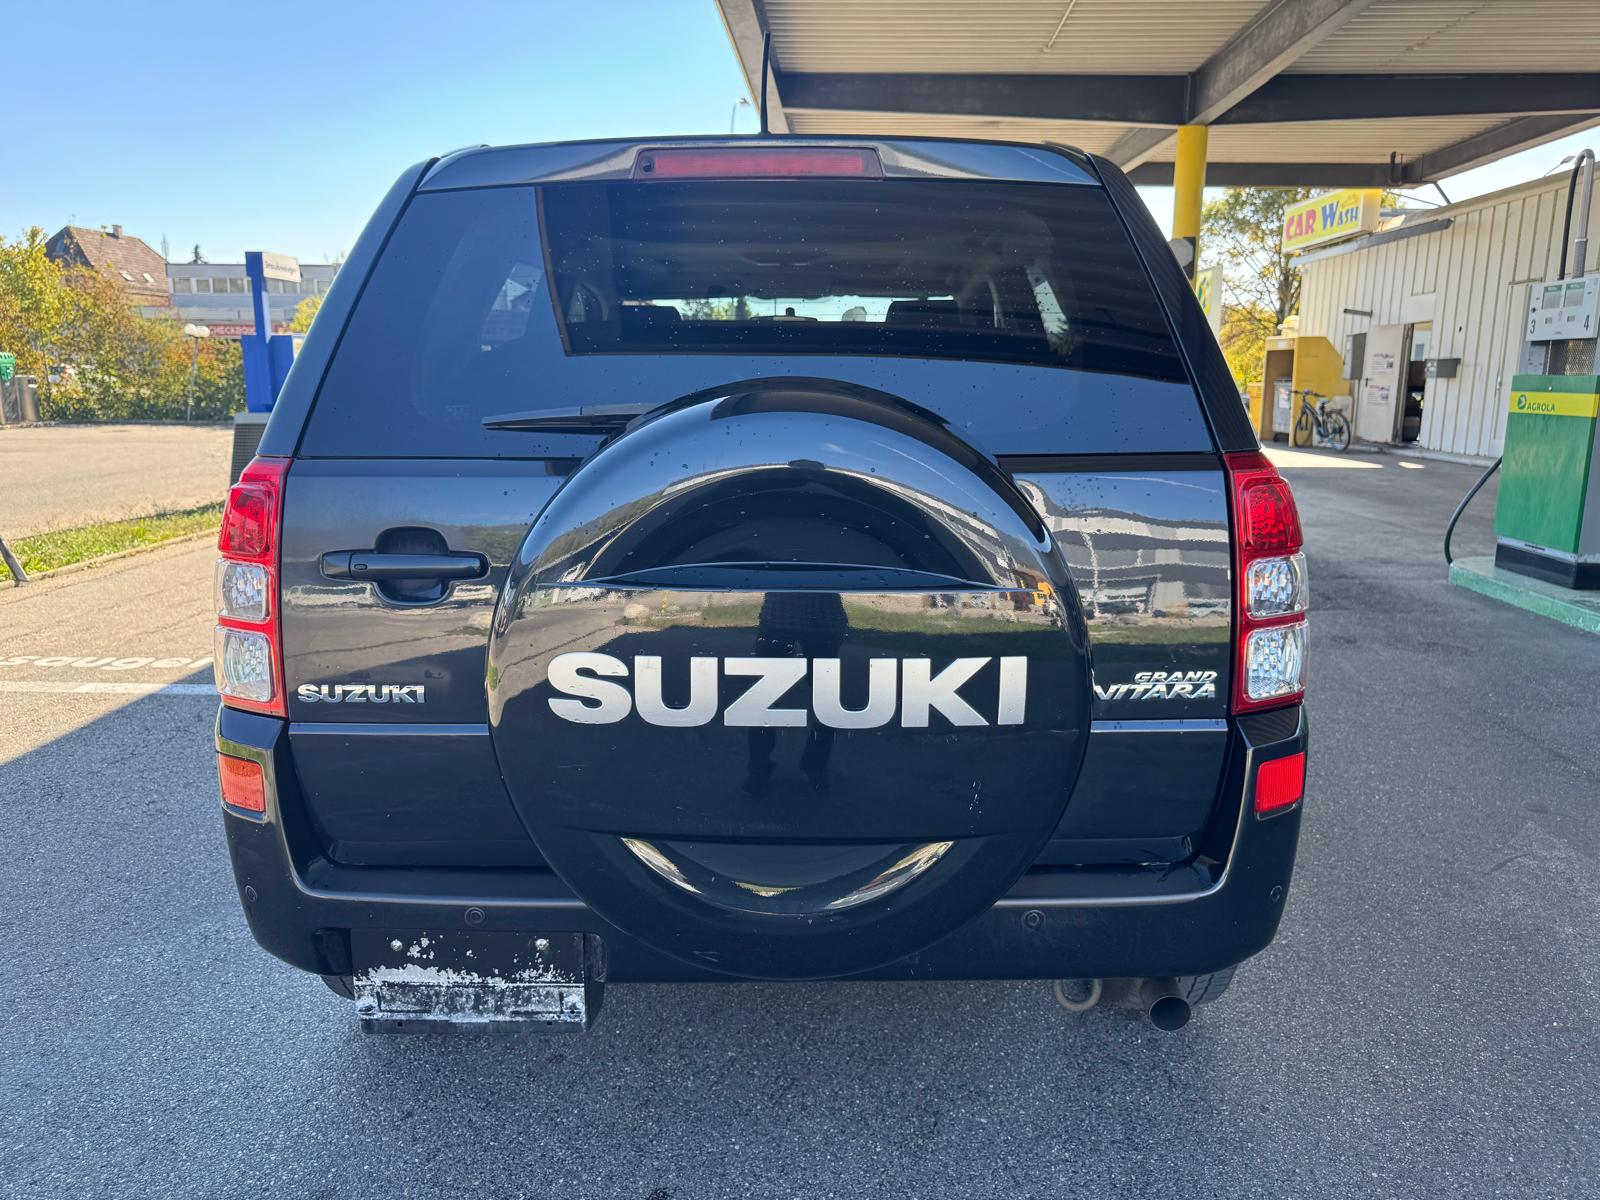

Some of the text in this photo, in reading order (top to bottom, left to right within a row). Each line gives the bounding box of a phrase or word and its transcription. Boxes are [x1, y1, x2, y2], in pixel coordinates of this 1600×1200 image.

[1285, 208, 1317, 241] CAR
[1530, 319, 1536, 334] 3
[1584, 314, 1590, 331] 4
[1526, 402, 1556, 412] AGROLA
[1134, 671, 1218, 683] GRAND
[297, 683, 425, 703] SUZUKI
[547, 652, 1027, 729] SUZUKI
[1093, 683, 1216, 700] VITARA
